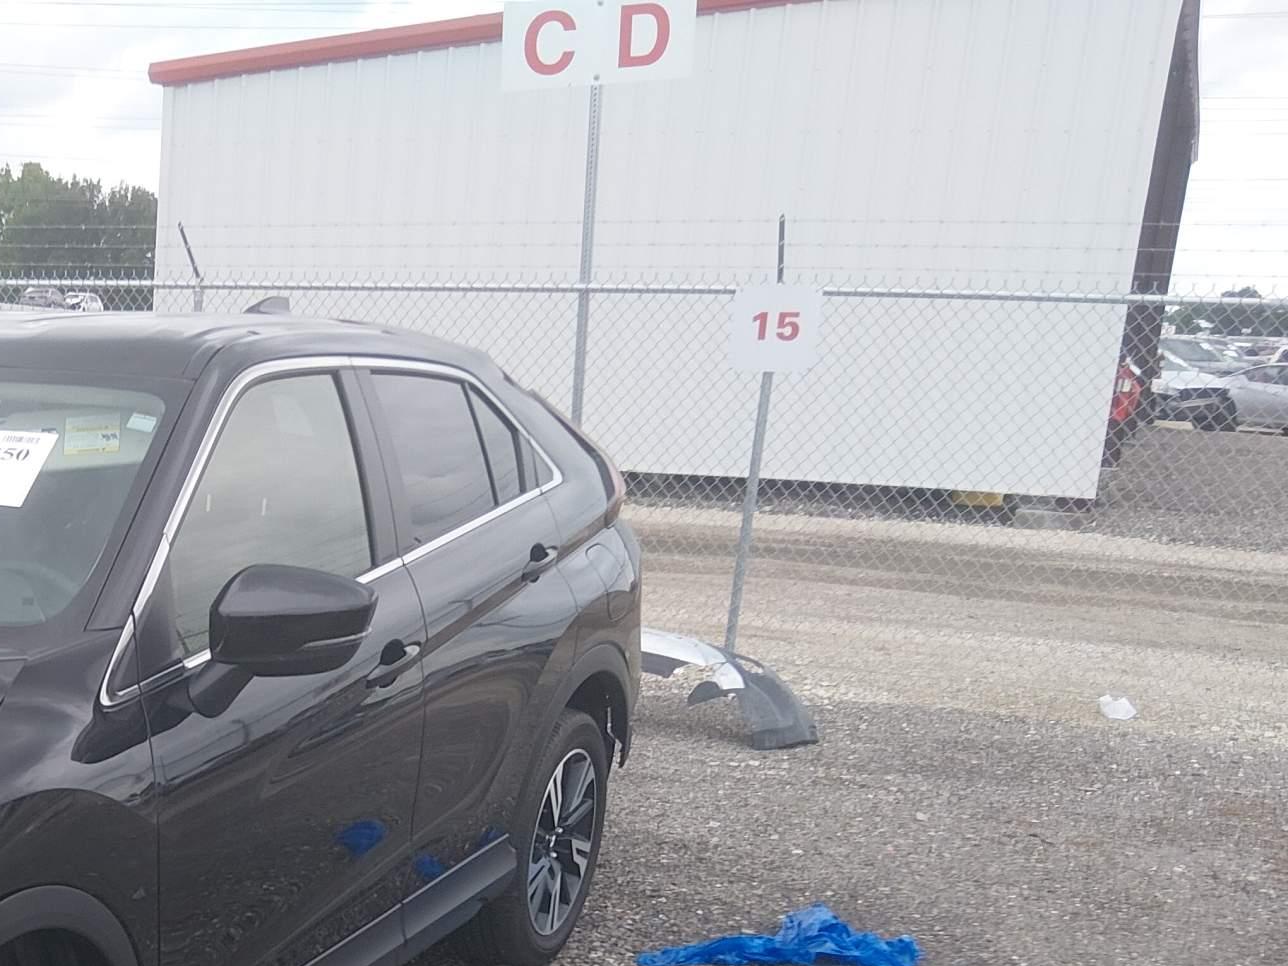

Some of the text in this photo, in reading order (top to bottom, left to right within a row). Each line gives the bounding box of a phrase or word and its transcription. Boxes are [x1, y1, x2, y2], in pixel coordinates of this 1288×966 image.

[524, 3, 670, 76] C D
[752, 311, 800, 342] 15
